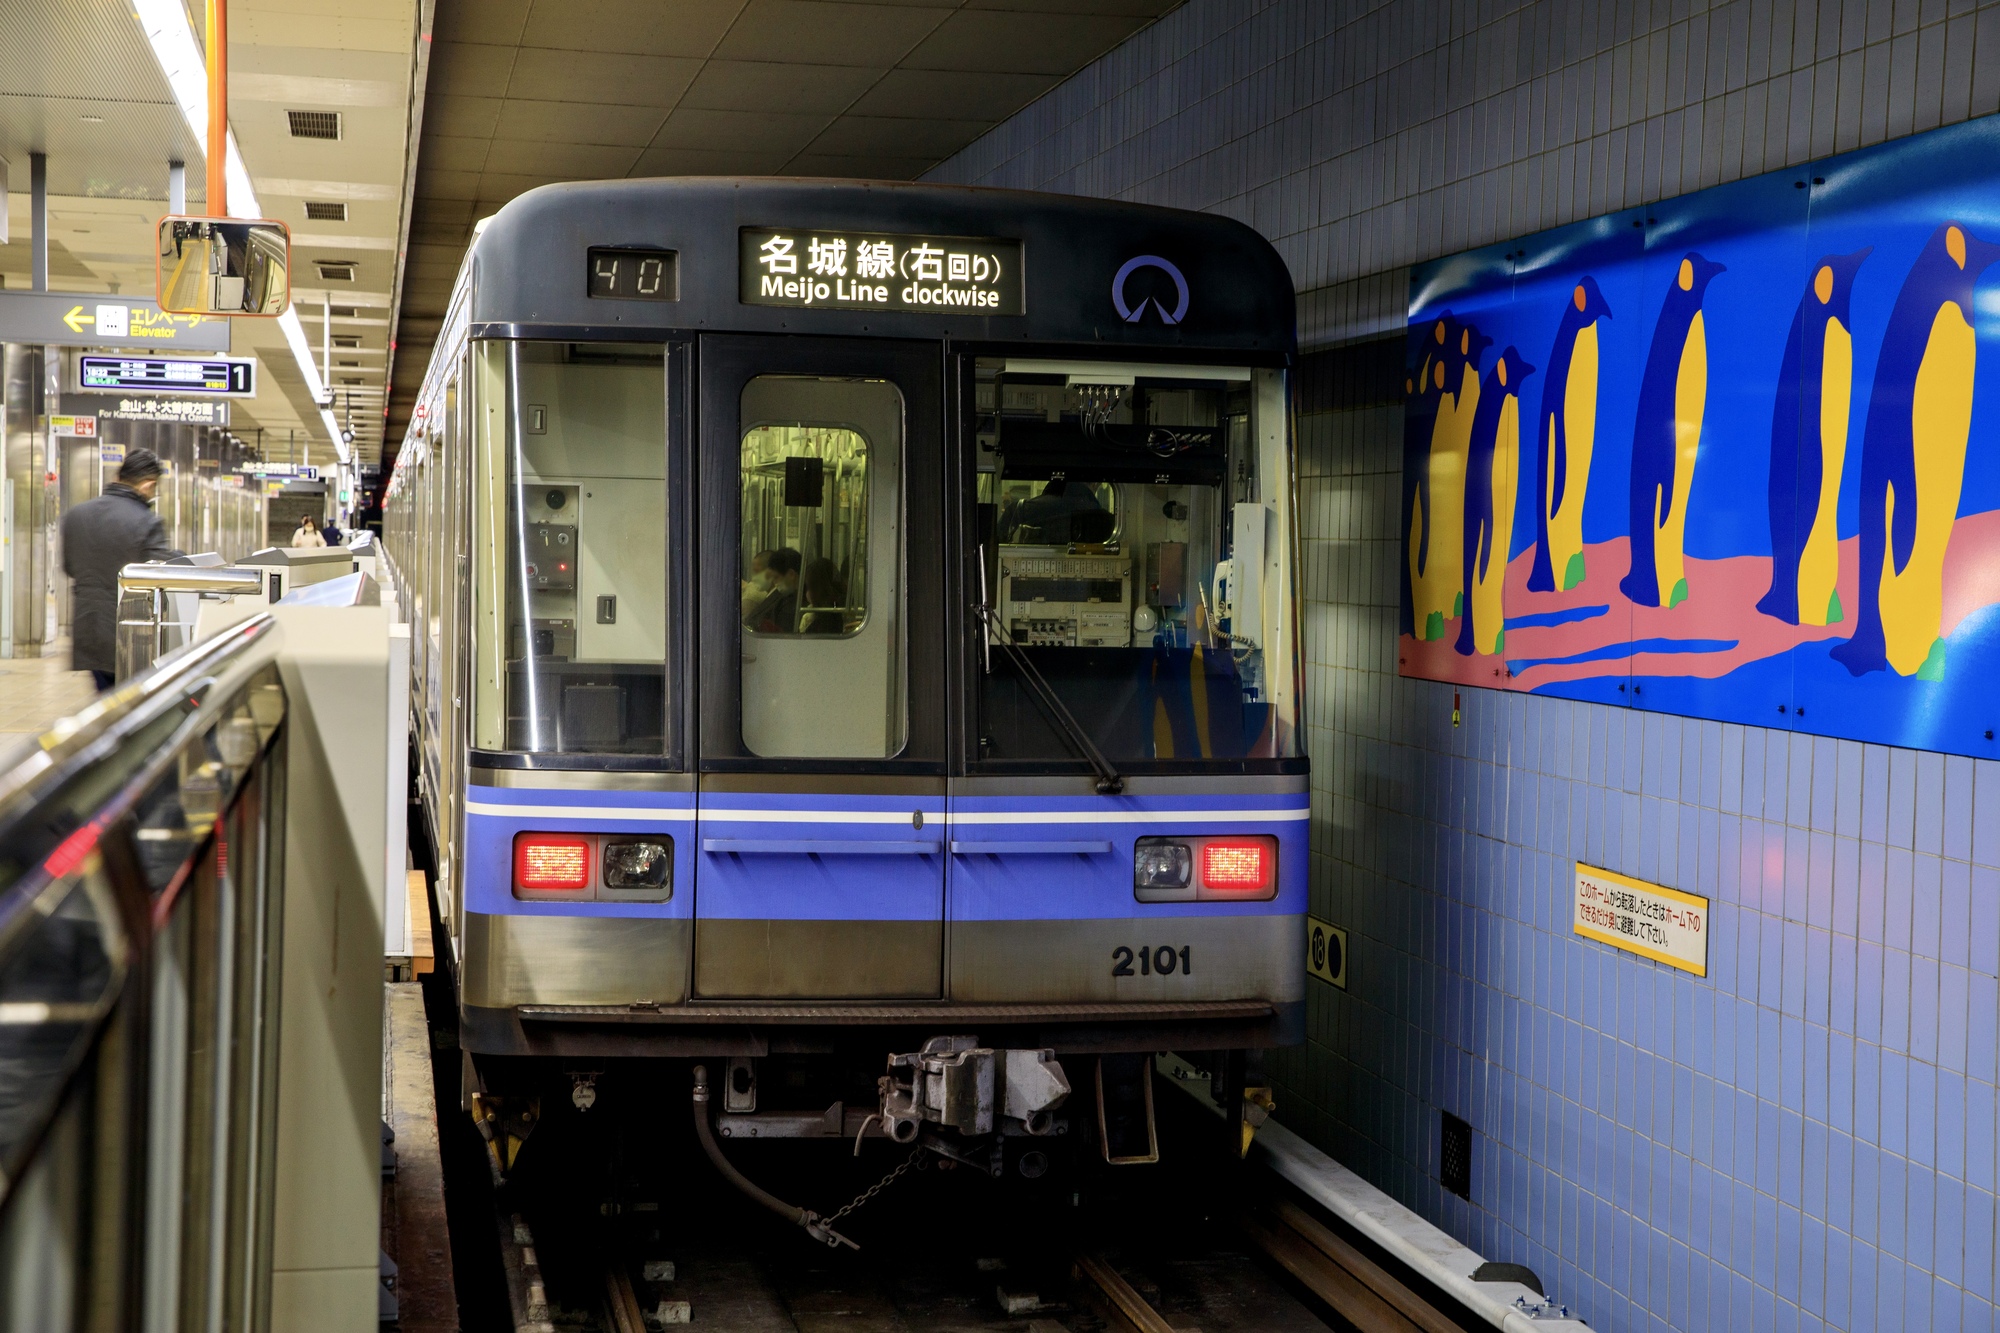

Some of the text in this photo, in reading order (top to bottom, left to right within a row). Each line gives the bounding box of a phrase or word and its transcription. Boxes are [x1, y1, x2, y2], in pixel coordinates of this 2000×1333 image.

[759, 235, 1001, 283] 名城線(右回り)
[596, 259, 662, 293] 40
[761, 275, 999, 307] Meijo Line clockwise
[130, 325, 176, 338] Elevator
[233, 366, 244, 389] 1
[99, 410, 112, 418] For
[216, 403, 225, 424] 1
[1580, 881, 1700, 932] このホームから転落したときはホーム下の
[1112, 945, 1191, 977] 2101
[1313, 933, 1324, 965] 18
